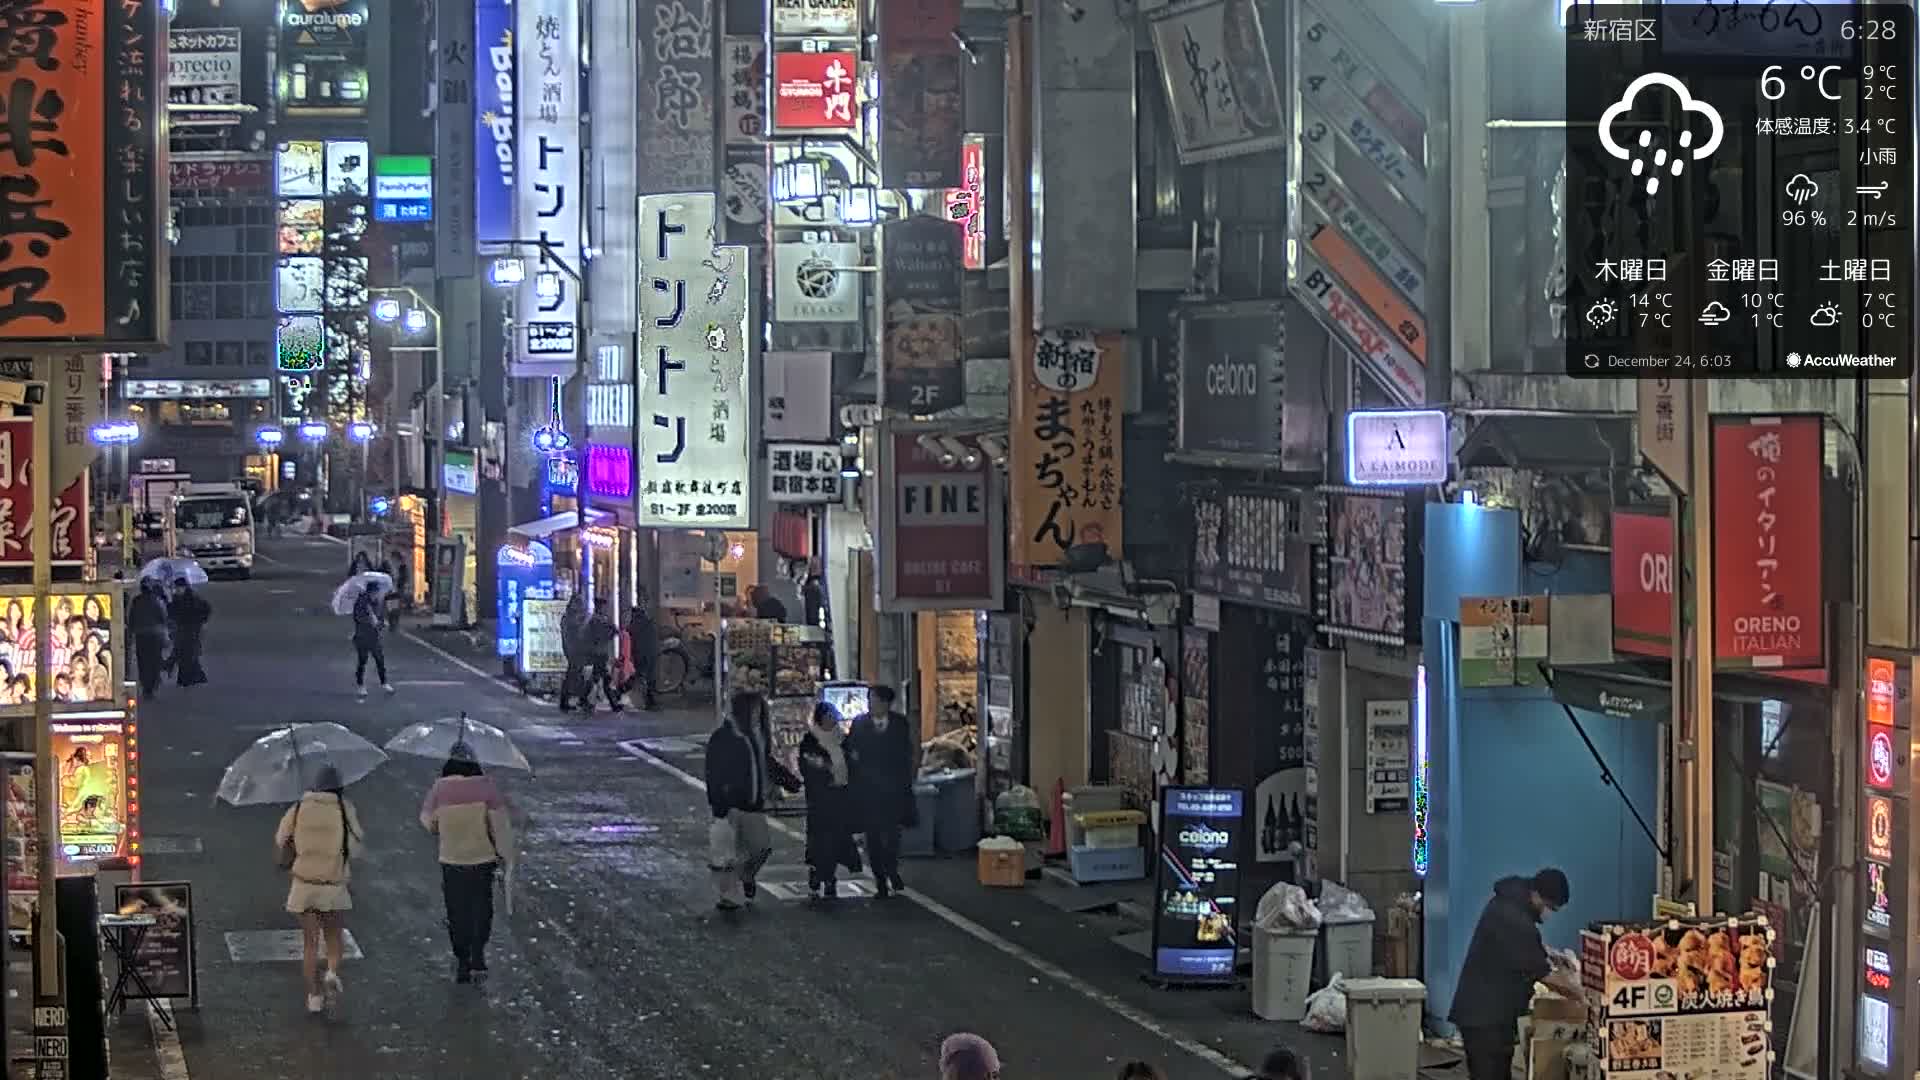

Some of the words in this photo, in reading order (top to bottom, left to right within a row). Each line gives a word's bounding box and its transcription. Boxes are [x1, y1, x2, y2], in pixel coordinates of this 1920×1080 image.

[1308, 23, 1328, 42] 5
[823, 59, 852, 121] 牛門
[1307, 75, 1328, 92] 4
[1307, 122, 1328, 143] 3
[379, 182, 428, 192] FamilyMart
[1306, 173, 1327, 193] 2
[120, 147, 145, 287] 楽しいお店
[1304, 269, 1334, 298] B1
[653, 209, 686, 463] トントン
[1207, 353, 1257, 395] celona
[911, 386, 940, 405] 2F
[773, 449, 838, 473] 酒場心
[1034, 396, 1078, 551] まっちゃん
[772, 476, 838, 495] 新宿本店
[904, 485, 980, 514] FINE
[1747, 431, 1783, 605] 俺のイタリアン
[1734, 615, 1801, 633] ORENO
[1733, 634, 1801, 653] ITALIAN
[1613, 986, 1646, 1009] 4F
[35, 1007, 66, 1027] NERO
[37, 1039, 67, 1057] NERO
